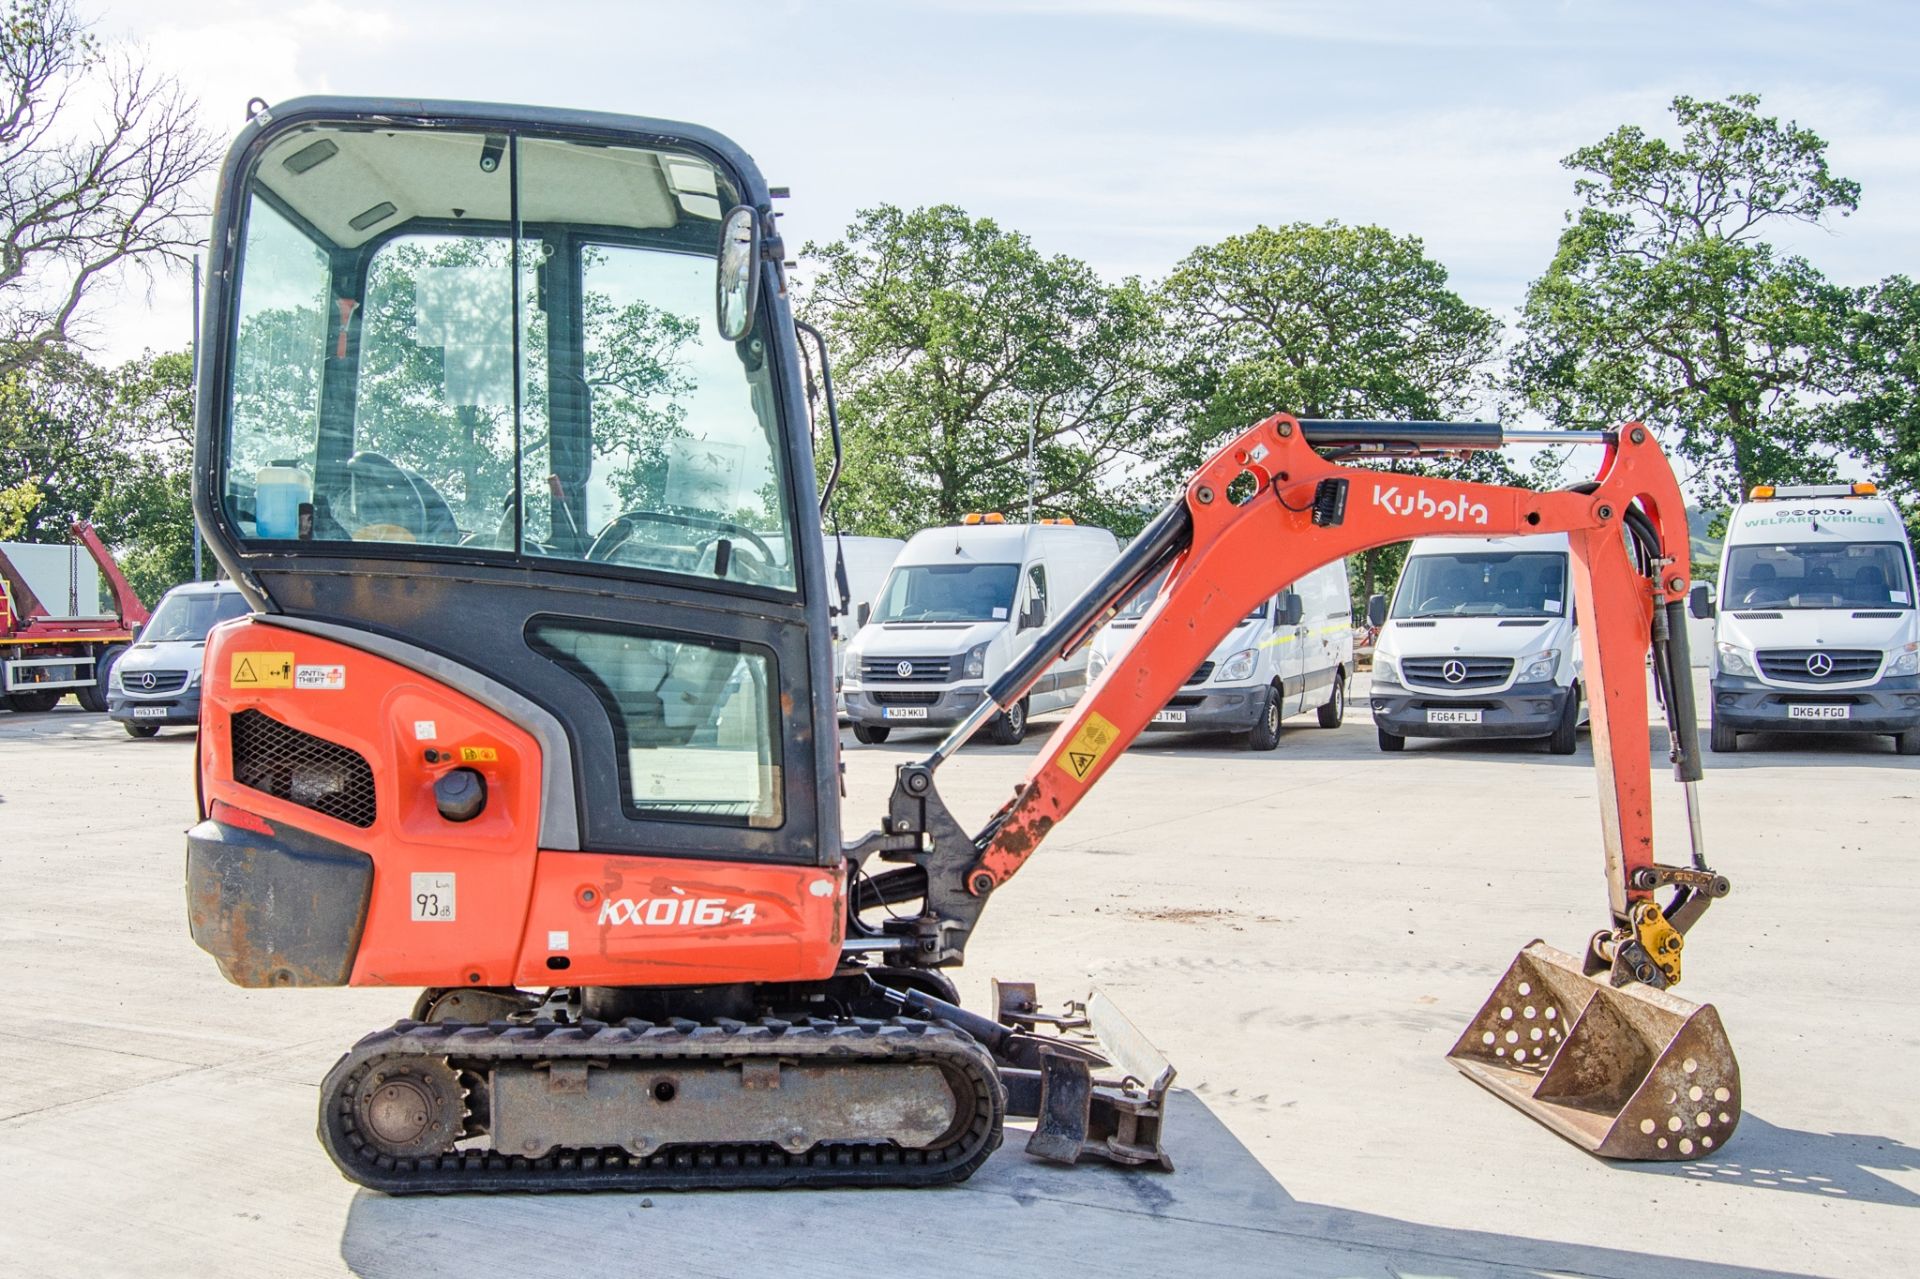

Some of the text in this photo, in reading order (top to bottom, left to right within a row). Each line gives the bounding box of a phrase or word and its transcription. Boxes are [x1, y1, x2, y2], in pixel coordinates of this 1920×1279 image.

[1372, 484, 1488, 525] Kubota
[1744, 514, 1886, 528] WELFARE VEHICLE
[889, 708, 924, 717] NJ13 MKU
[1431, 712, 1478, 722] FG64 FLJ
[1793, 707, 1820, 717] DK64
[416, 893, 451, 917] 93 dB
